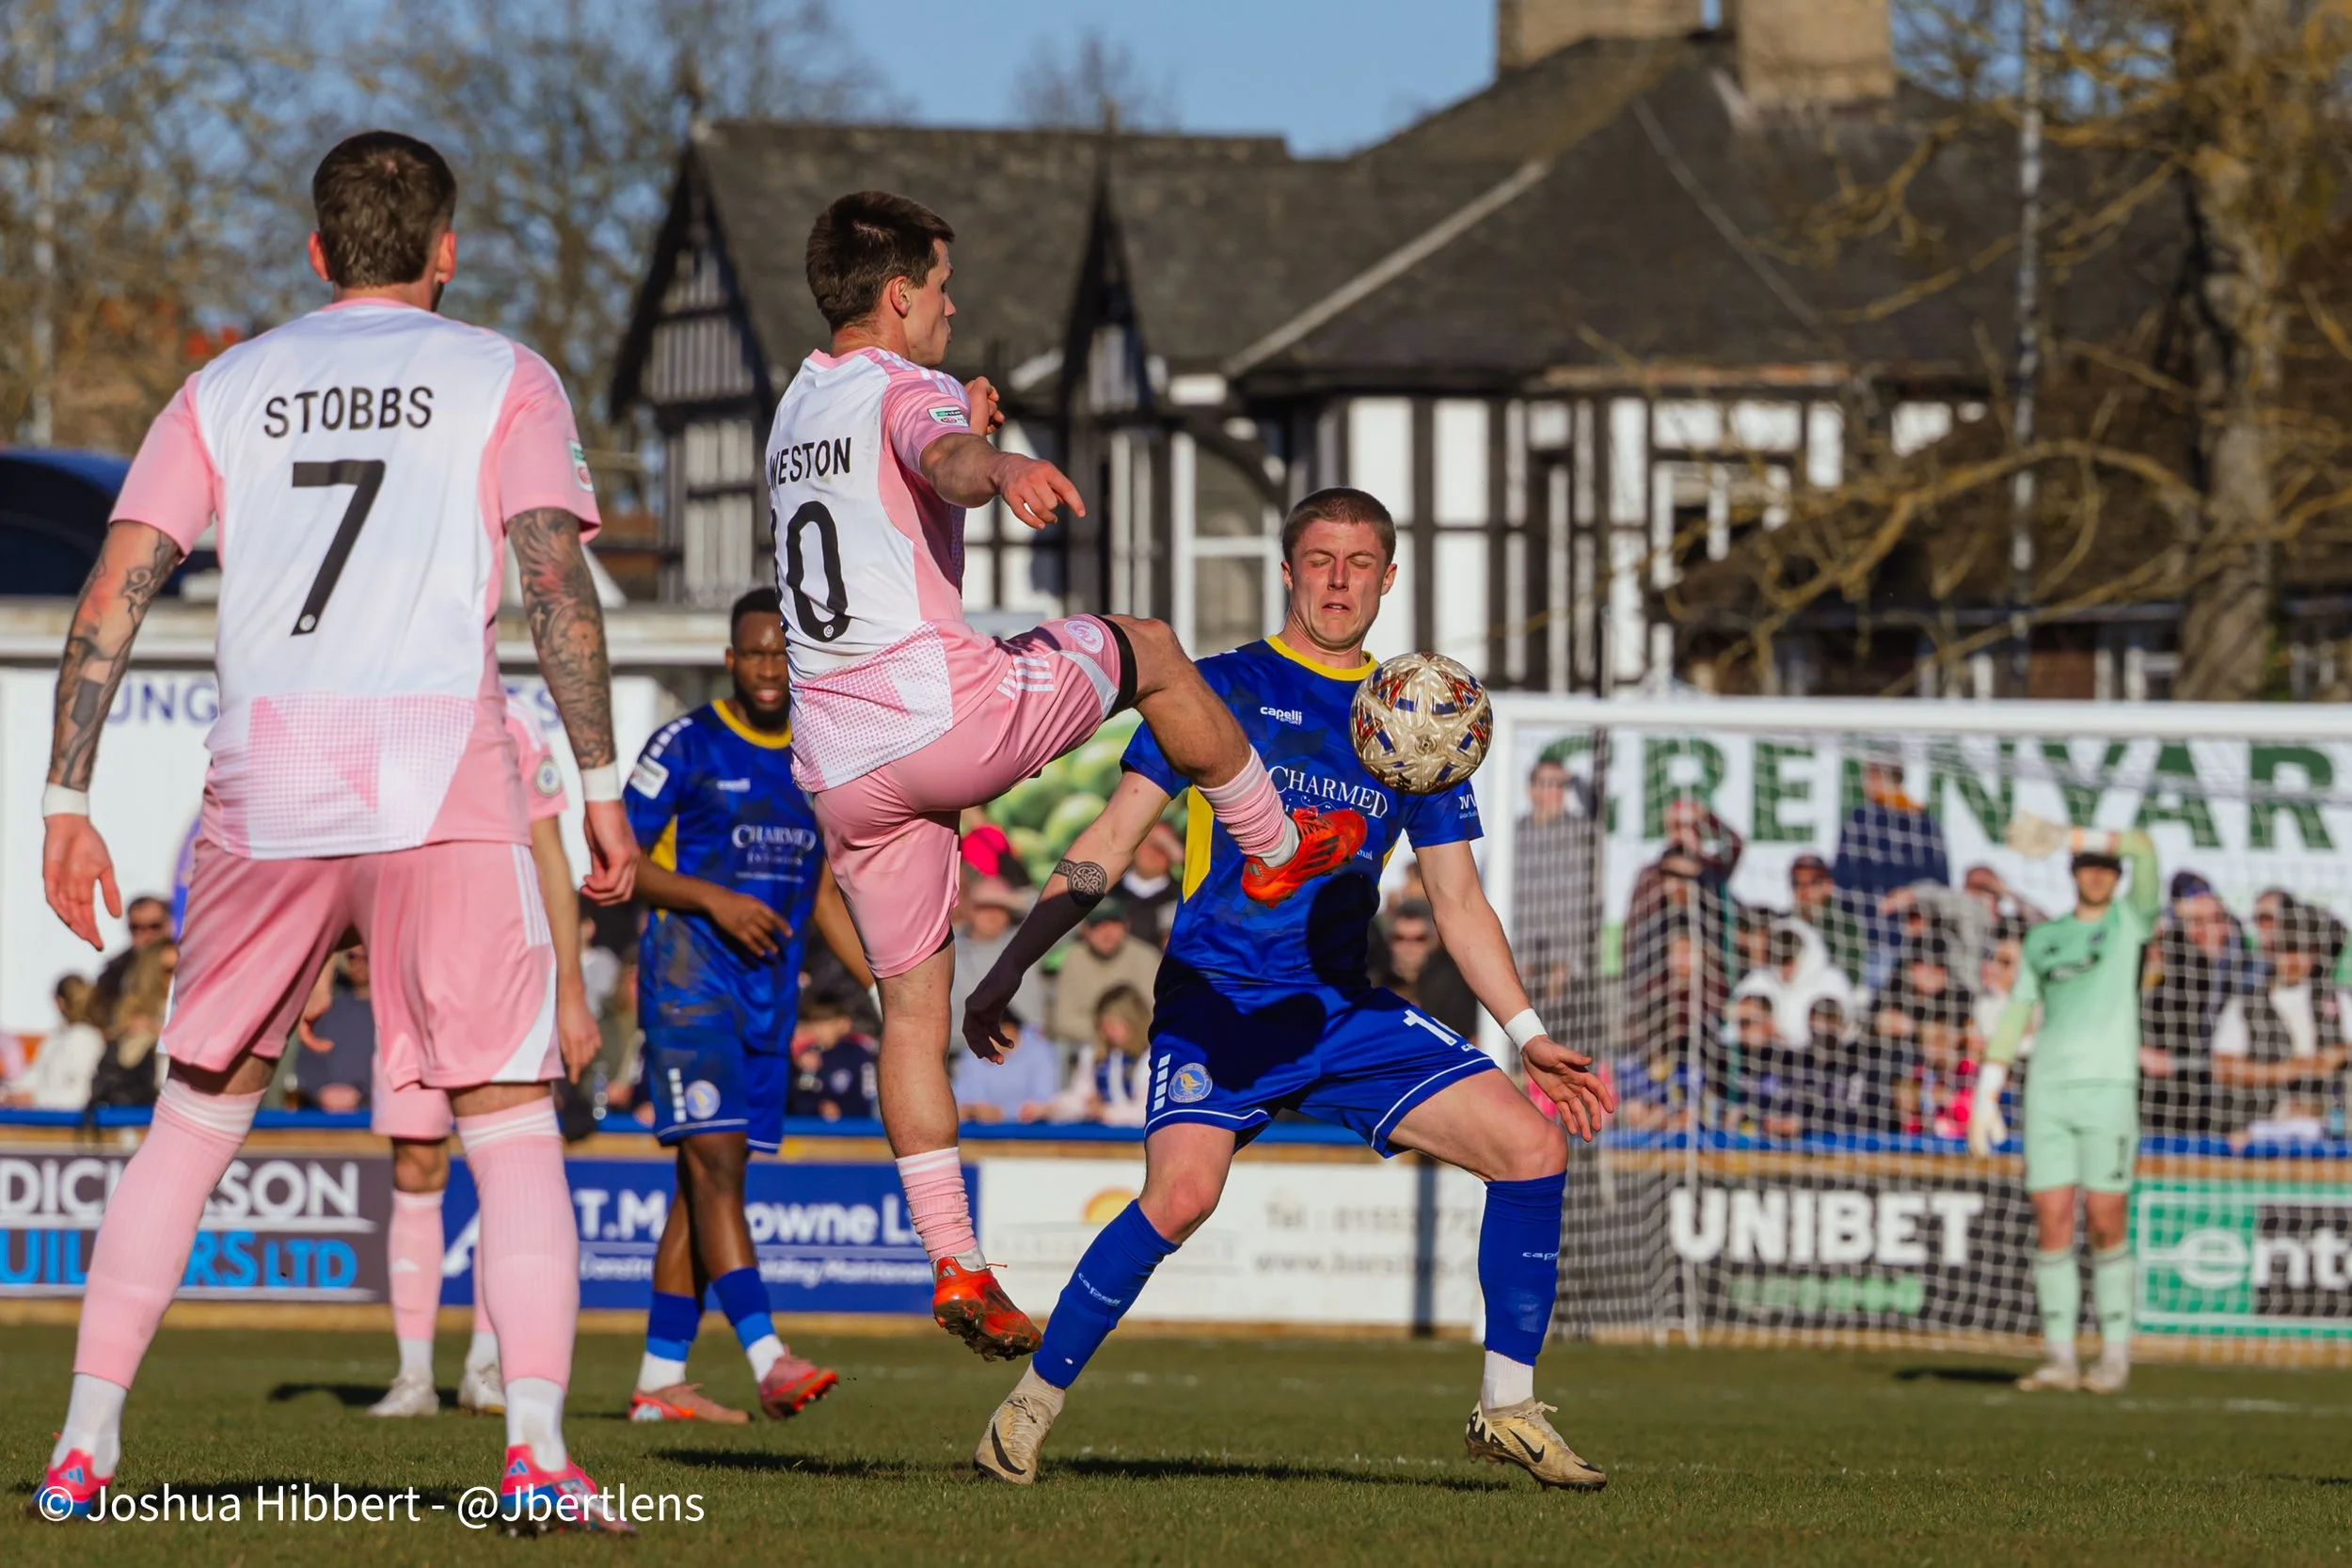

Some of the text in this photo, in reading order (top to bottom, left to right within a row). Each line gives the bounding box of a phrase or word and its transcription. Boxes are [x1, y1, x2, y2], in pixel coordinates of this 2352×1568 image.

[263, 386, 435, 438] STOBBS
[769, 436, 851, 491] WESTON
[290, 459, 387, 637] 7
[1260, 706, 1303, 722] capelli
[1268, 765, 1389, 819] CHARMED
[0, 1157, 359, 1218] DICSON
[745, 1199, 879, 1245] owne
[1669, 1186, 1984, 1265] UNIBET
[0, 1228, 358, 1290] UILRS LTD
[2176, 1226, 2352, 1291] ent
